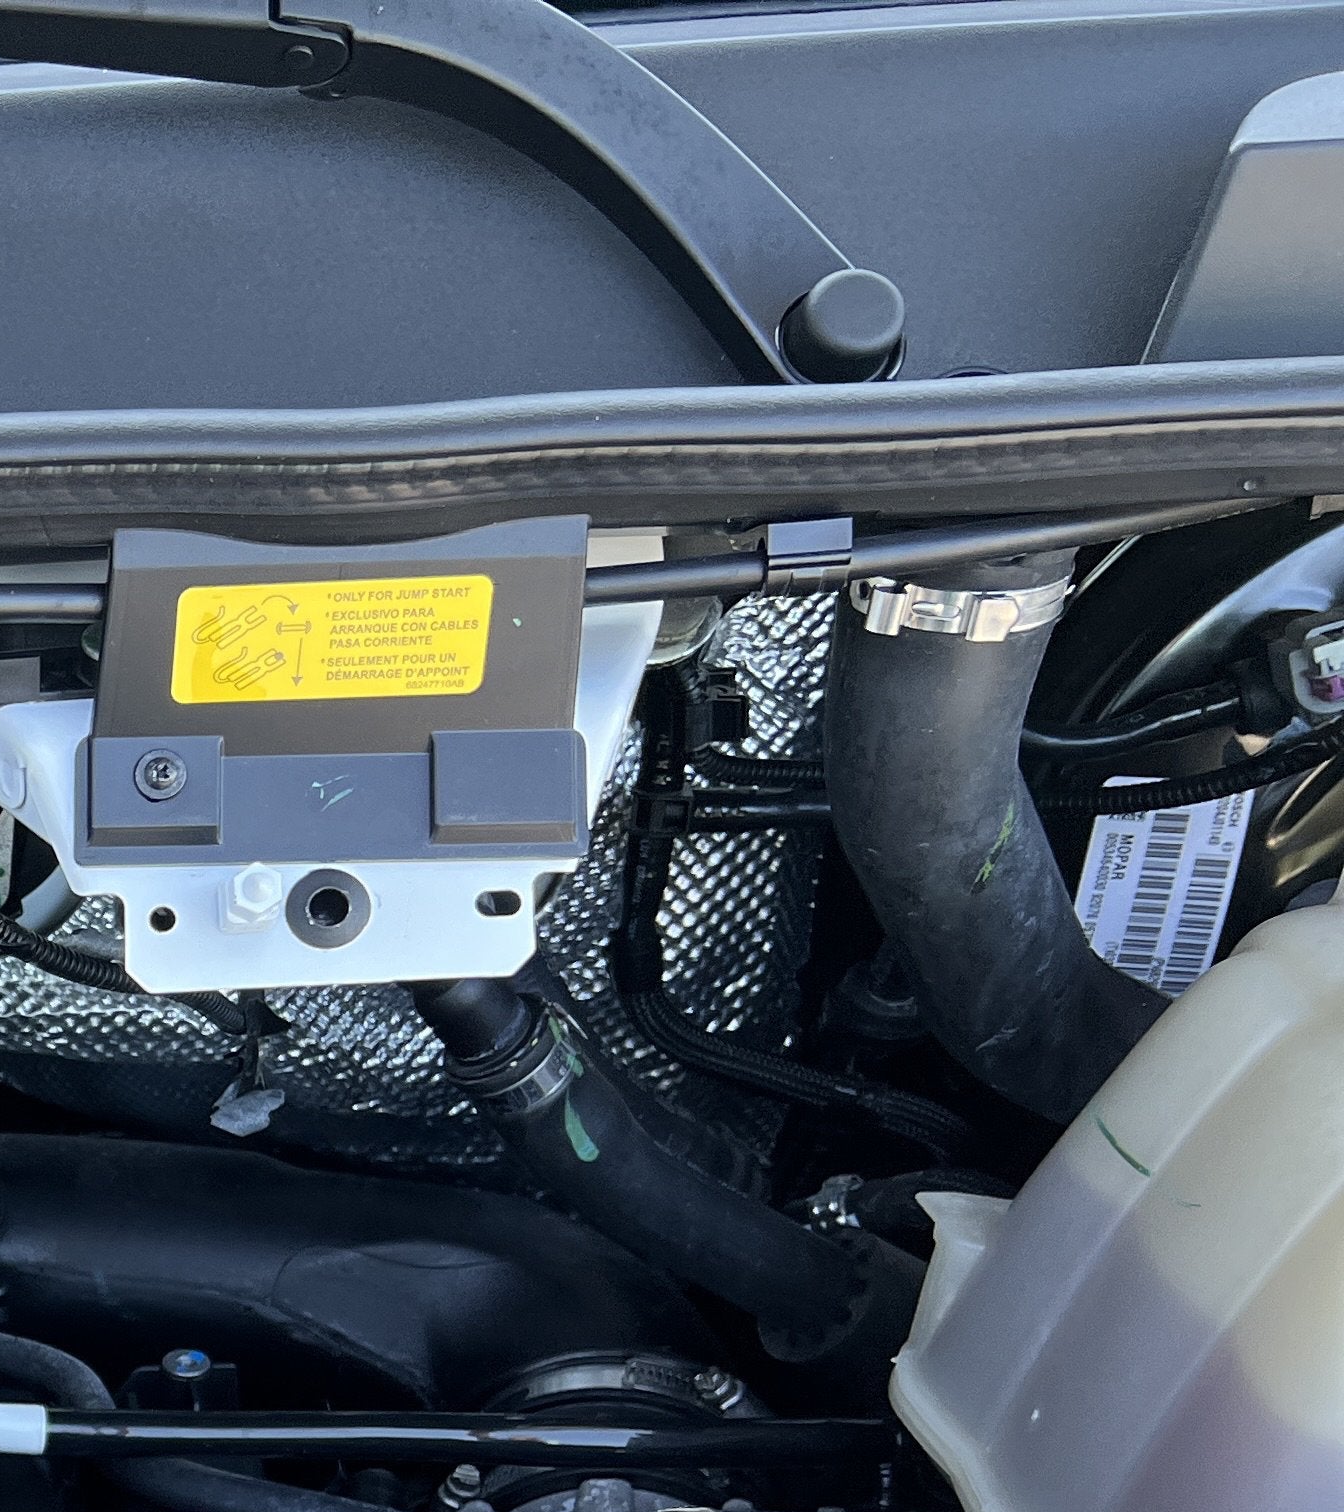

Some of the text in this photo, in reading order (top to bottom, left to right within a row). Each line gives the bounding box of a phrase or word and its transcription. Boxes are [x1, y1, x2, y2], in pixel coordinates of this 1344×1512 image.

[333, 587, 471, 602] ONLY FOR JUMP START
[332, 608, 435, 621] EXCLUSIVO PARA
[330, 620, 479, 635] ARRANQUE CON CABLES
[329, 636, 432, 648] PASA CORRIENTE
[326, 653, 456, 667] SEULEMENT POUR UN
[326, 666, 470, 680] DÉMARRAGE D'APPOINT
[1111, 834, 1134, 881] MOPAR
